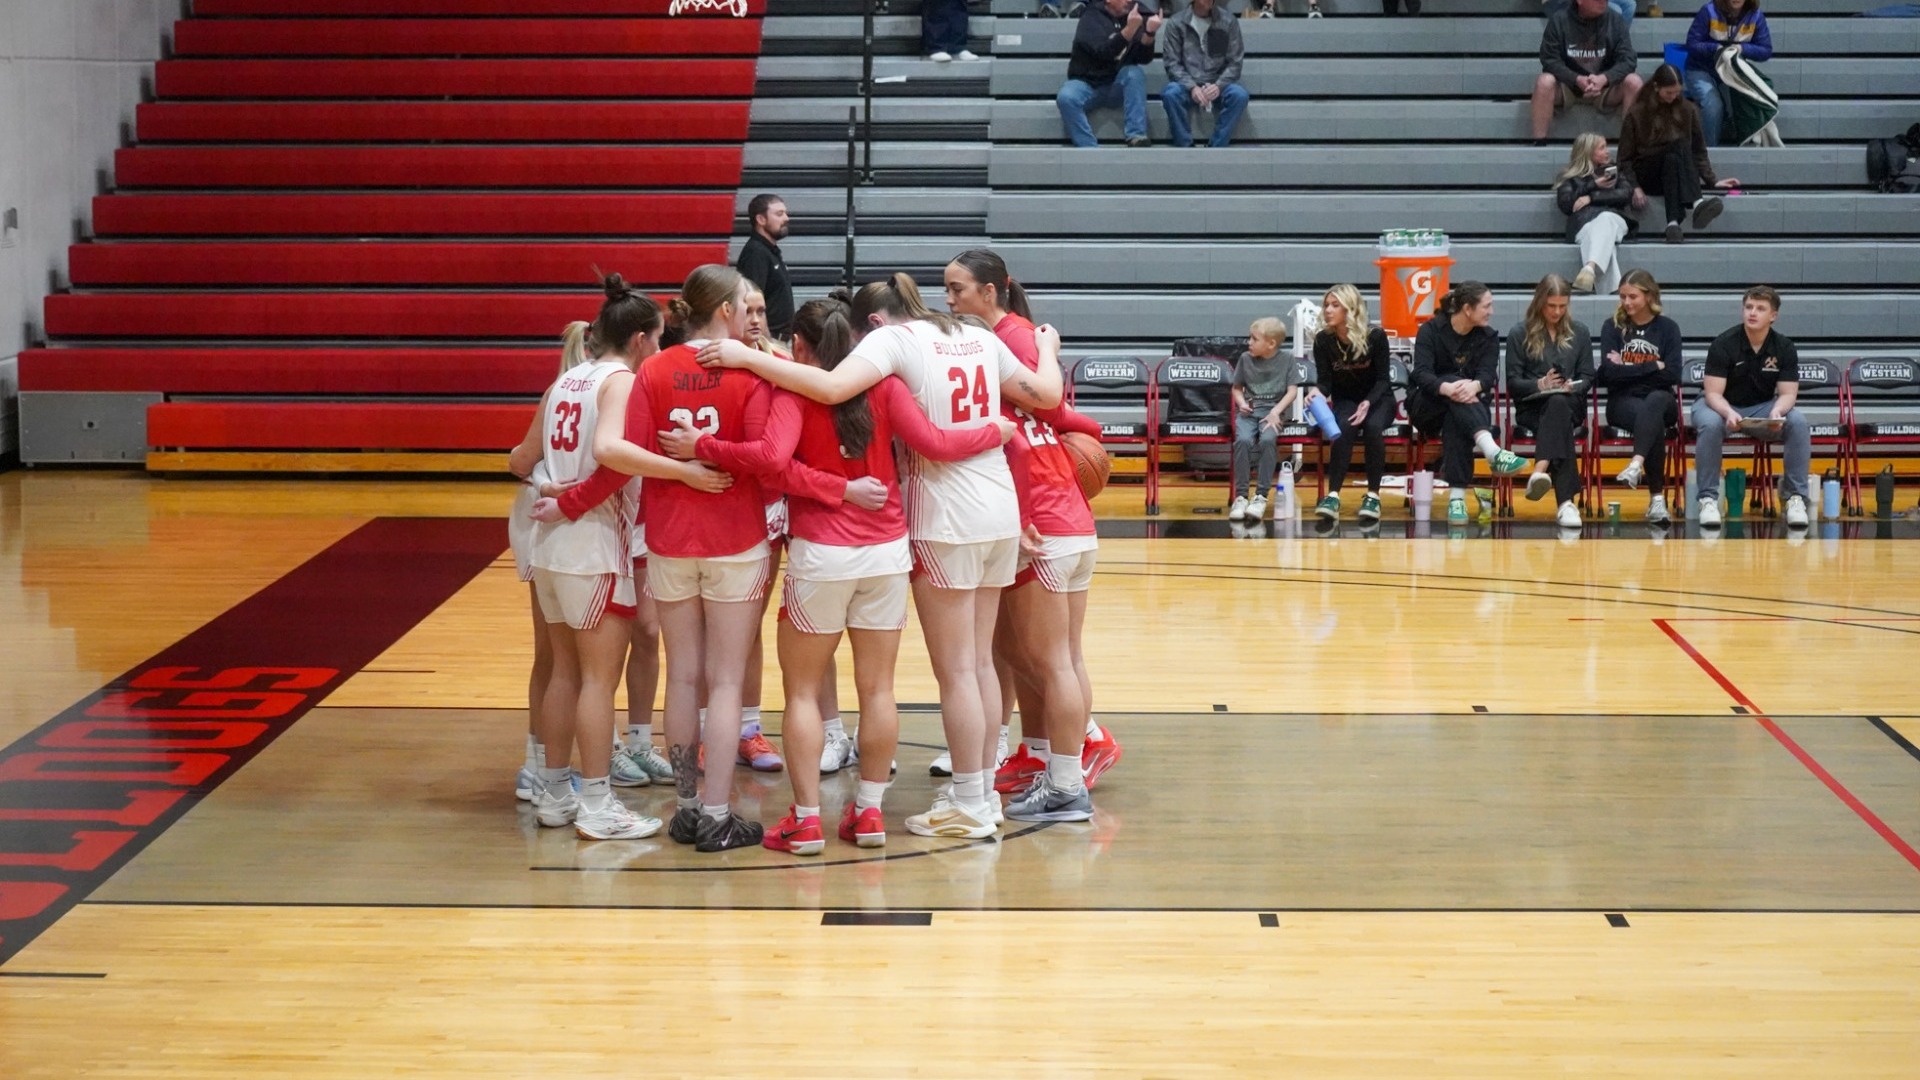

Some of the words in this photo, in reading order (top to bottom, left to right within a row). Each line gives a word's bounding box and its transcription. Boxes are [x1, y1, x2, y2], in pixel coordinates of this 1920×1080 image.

[1410, 270, 1432, 294] G
[933, 340, 984, 356] BULLDOGS
[1086, 367, 1135, 377] WESTERN
[1170, 368, 1219, 379] WESTERN
[1798, 371, 1825, 379] TERN
[1862, 368, 1911, 378] WESTERN
[672, 370, 723, 391] SAYLER
[947, 364, 990, 424] 24
[550, 401, 582, 452] 33
[1101, 425, 1135, 435] LDOGS
[1169, 425, 1219, 435] BULLDOGS
[1809, 426, 1839, 435] LDOGS
